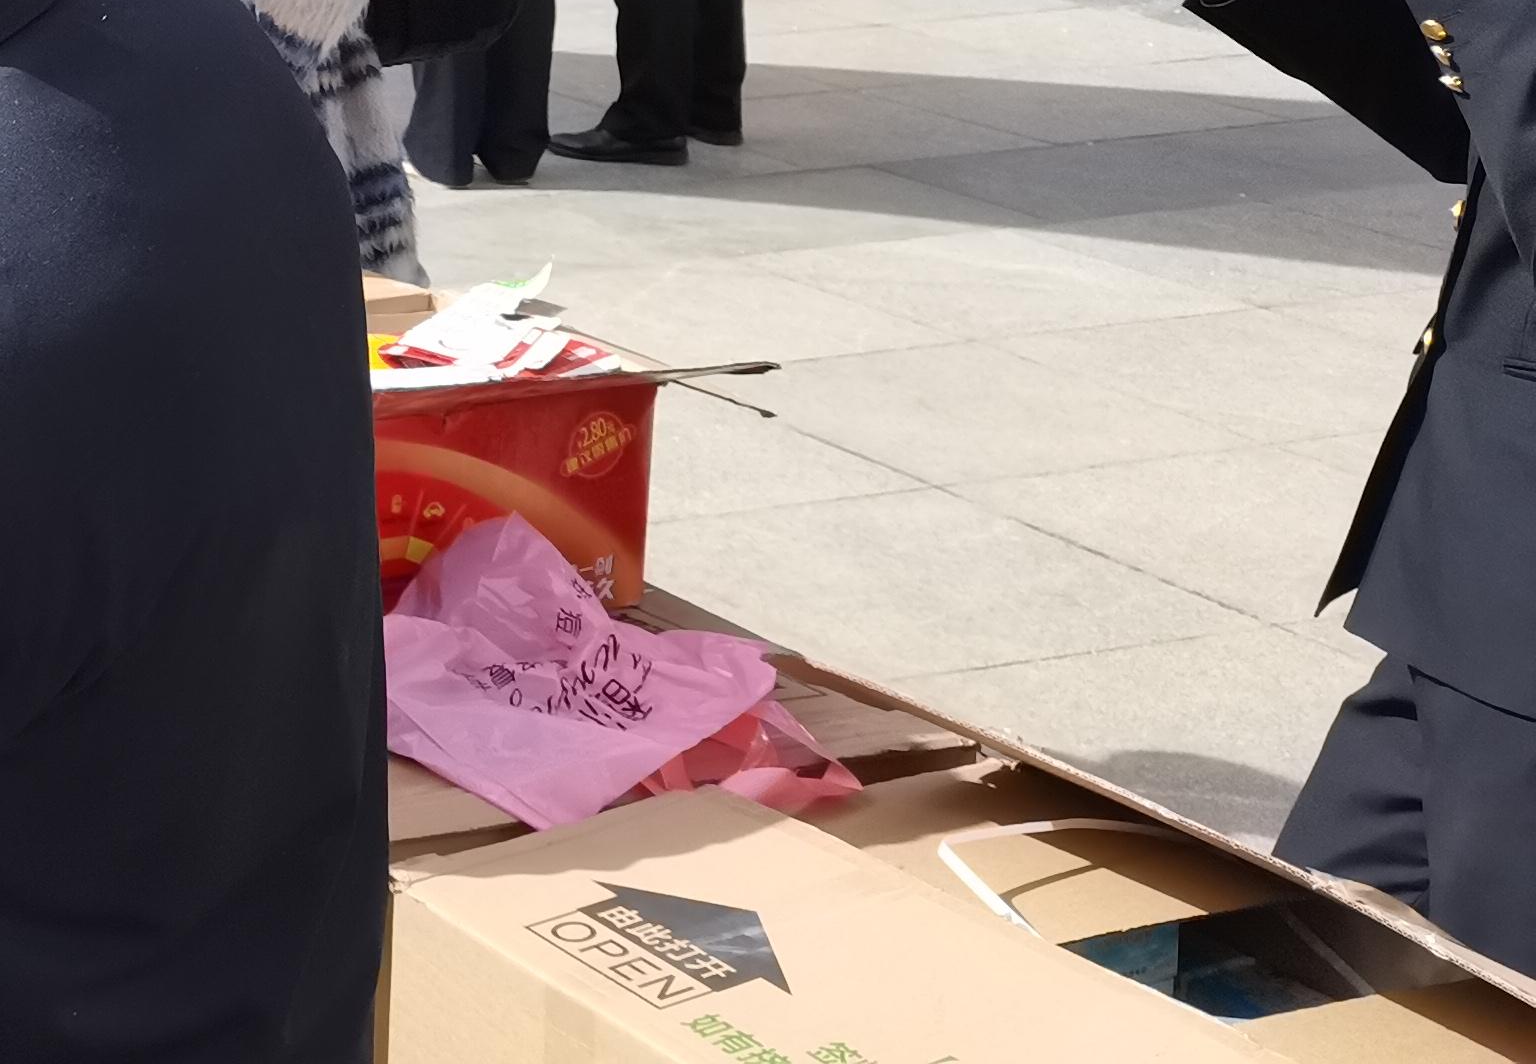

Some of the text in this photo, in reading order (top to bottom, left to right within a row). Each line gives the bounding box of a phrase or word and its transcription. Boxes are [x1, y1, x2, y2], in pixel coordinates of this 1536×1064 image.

[549, 920, 696, 1001] OPEN
[597, 905, 738, 979] 由此打开
